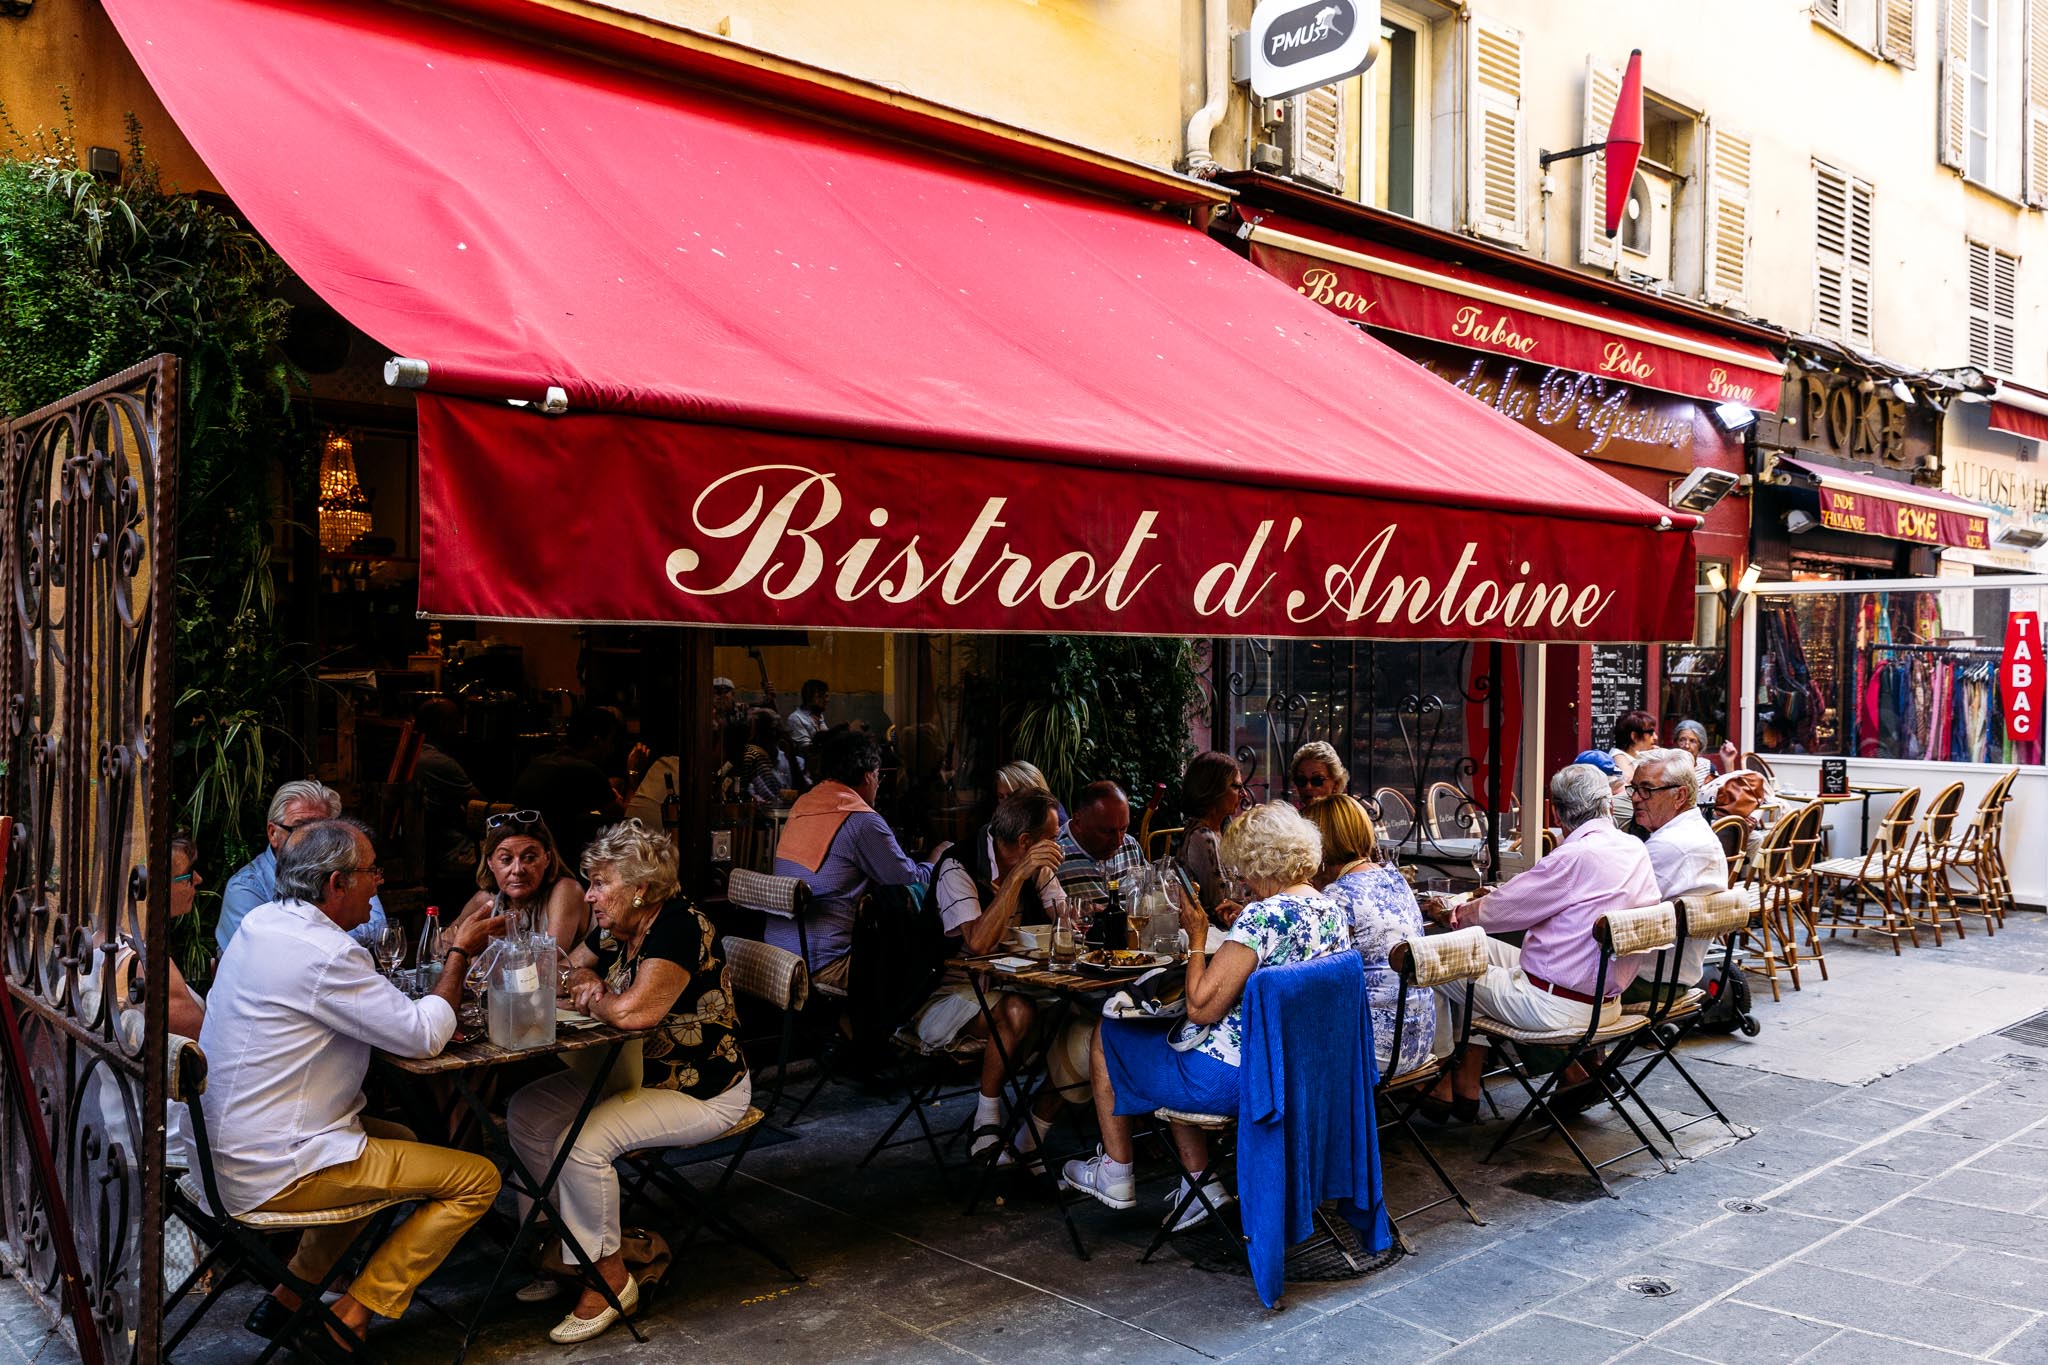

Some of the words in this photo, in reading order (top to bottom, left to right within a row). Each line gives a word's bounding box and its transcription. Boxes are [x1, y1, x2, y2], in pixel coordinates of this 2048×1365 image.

[1271, 23, 1316, 55] PMU
[1298, 268, 1377, 315] Bar
[1451, 306, 1539, 353] Tabac
[1600, 342, 1655, 379] Loto
[1707, 367, 1757, 402] Pmu
[1802, 375, 1906, 461] POKE
[666, 464, 1162, 611] Bistrot
[1193, 517, 1616, 628] d'Antoine
[2012, 618, 2032, 733] TABAC
